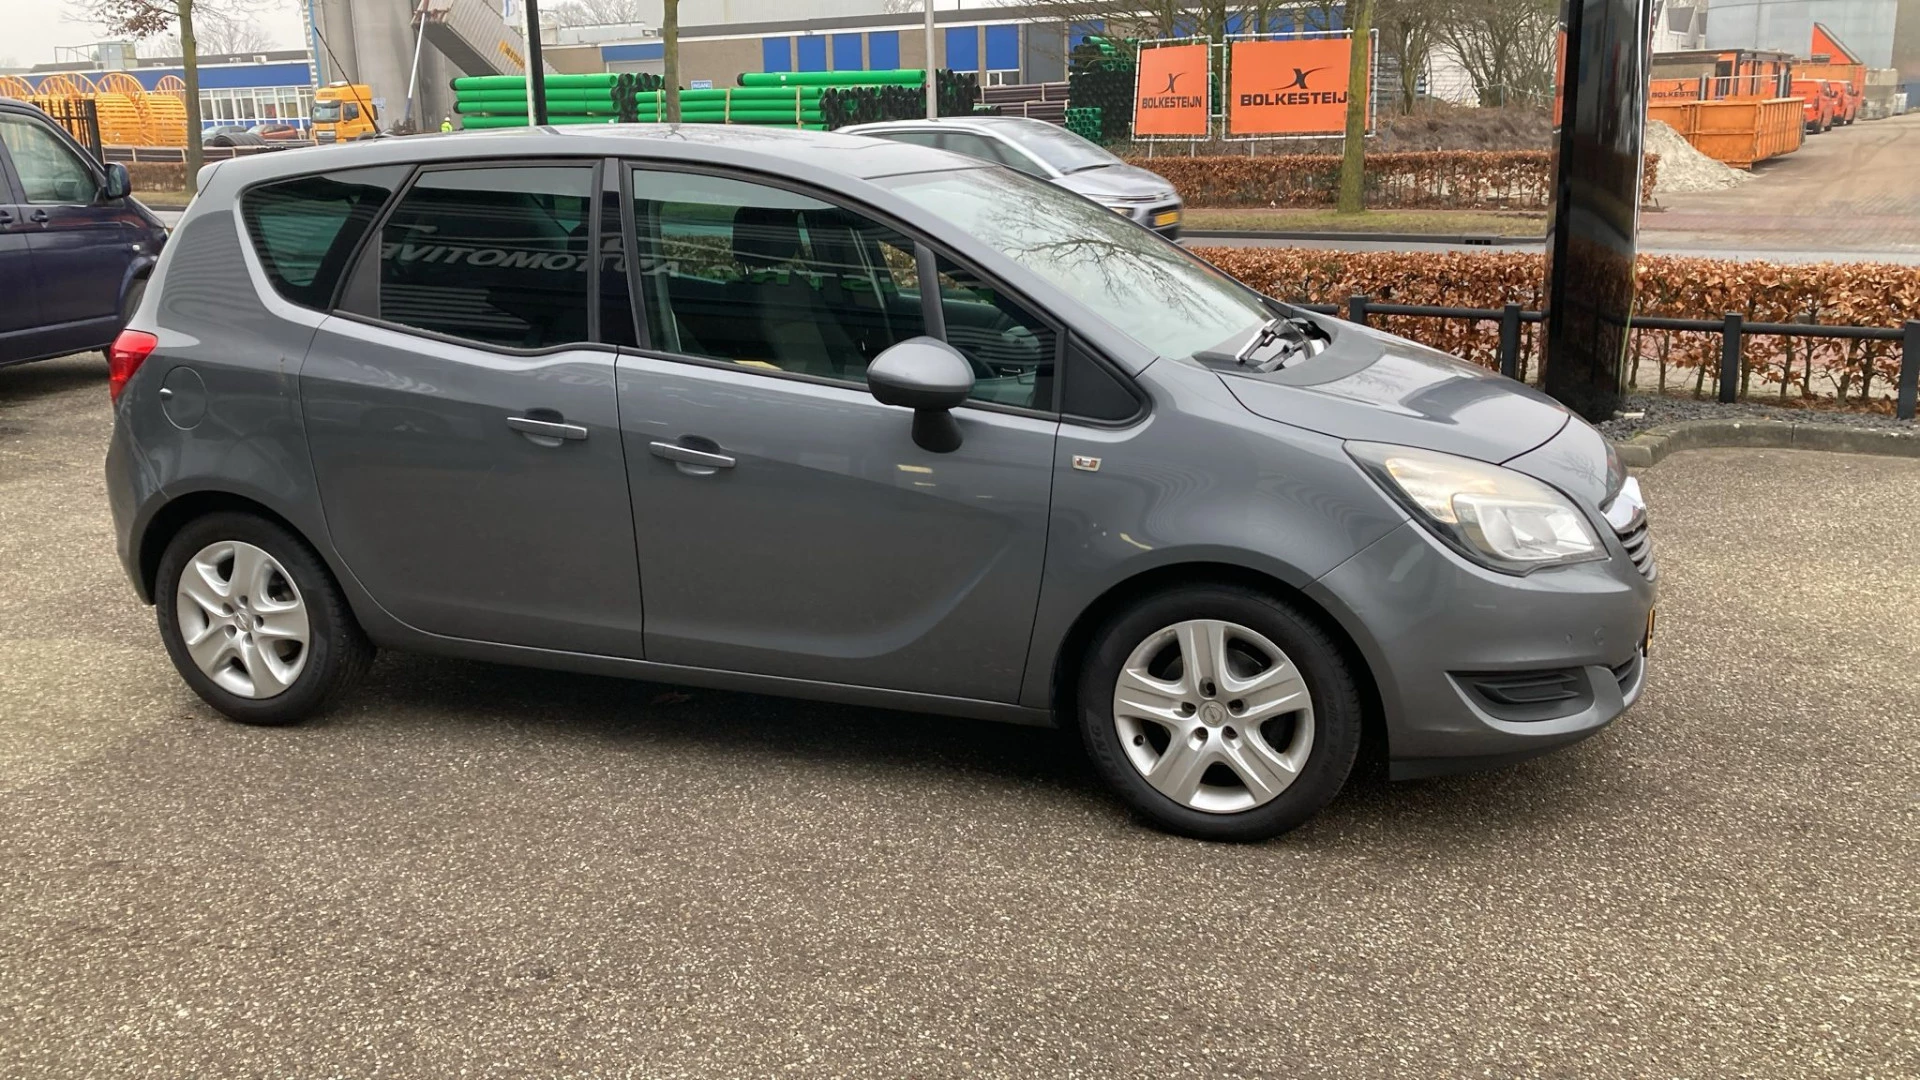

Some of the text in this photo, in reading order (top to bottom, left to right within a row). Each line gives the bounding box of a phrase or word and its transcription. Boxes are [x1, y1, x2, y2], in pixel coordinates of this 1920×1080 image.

[1240, 91, 1348, 106] BOLKESTEIJ
[1651, 90, 1698, 98] BOLKESTEI
[1142, 96, 1202, 109] BOLKESTEIJN
